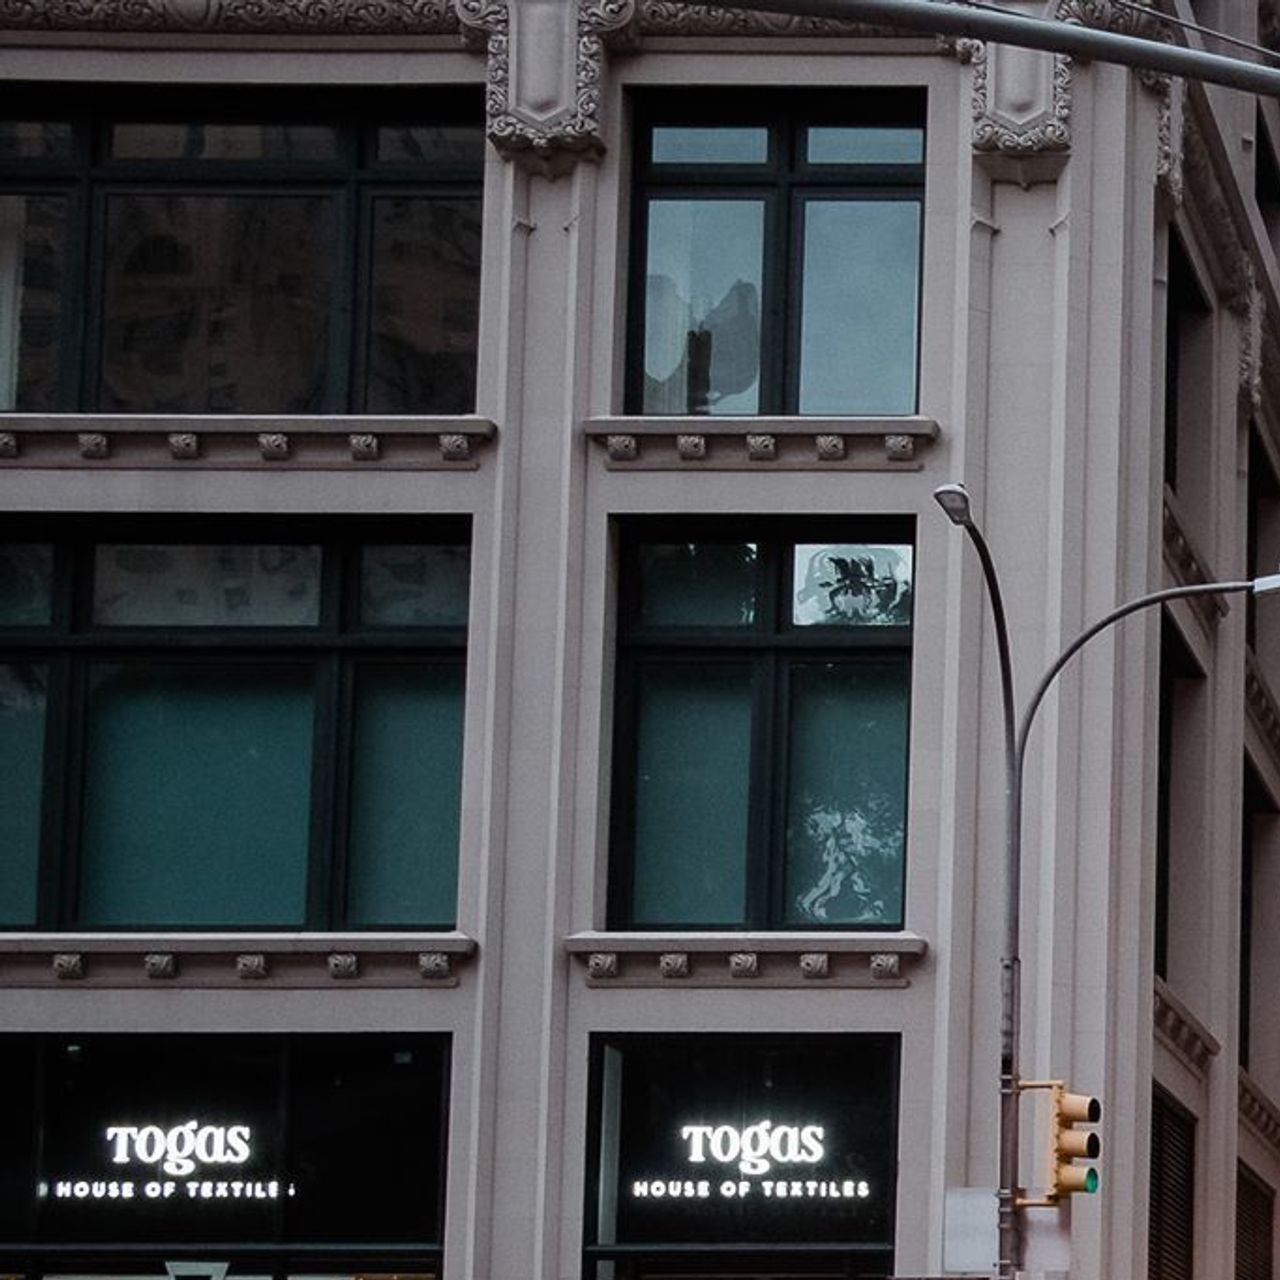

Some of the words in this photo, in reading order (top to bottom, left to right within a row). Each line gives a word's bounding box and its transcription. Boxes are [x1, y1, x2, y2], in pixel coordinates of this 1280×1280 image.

[56, 1181, 134, 1198] HOUSE
[144, 1181, 175, 1198] OF
[633, 1180, 709, 1197] HOUSE
[720, 1180, 750, 1197] OF
[762, 1180, 869, 1197] TEXTILES
